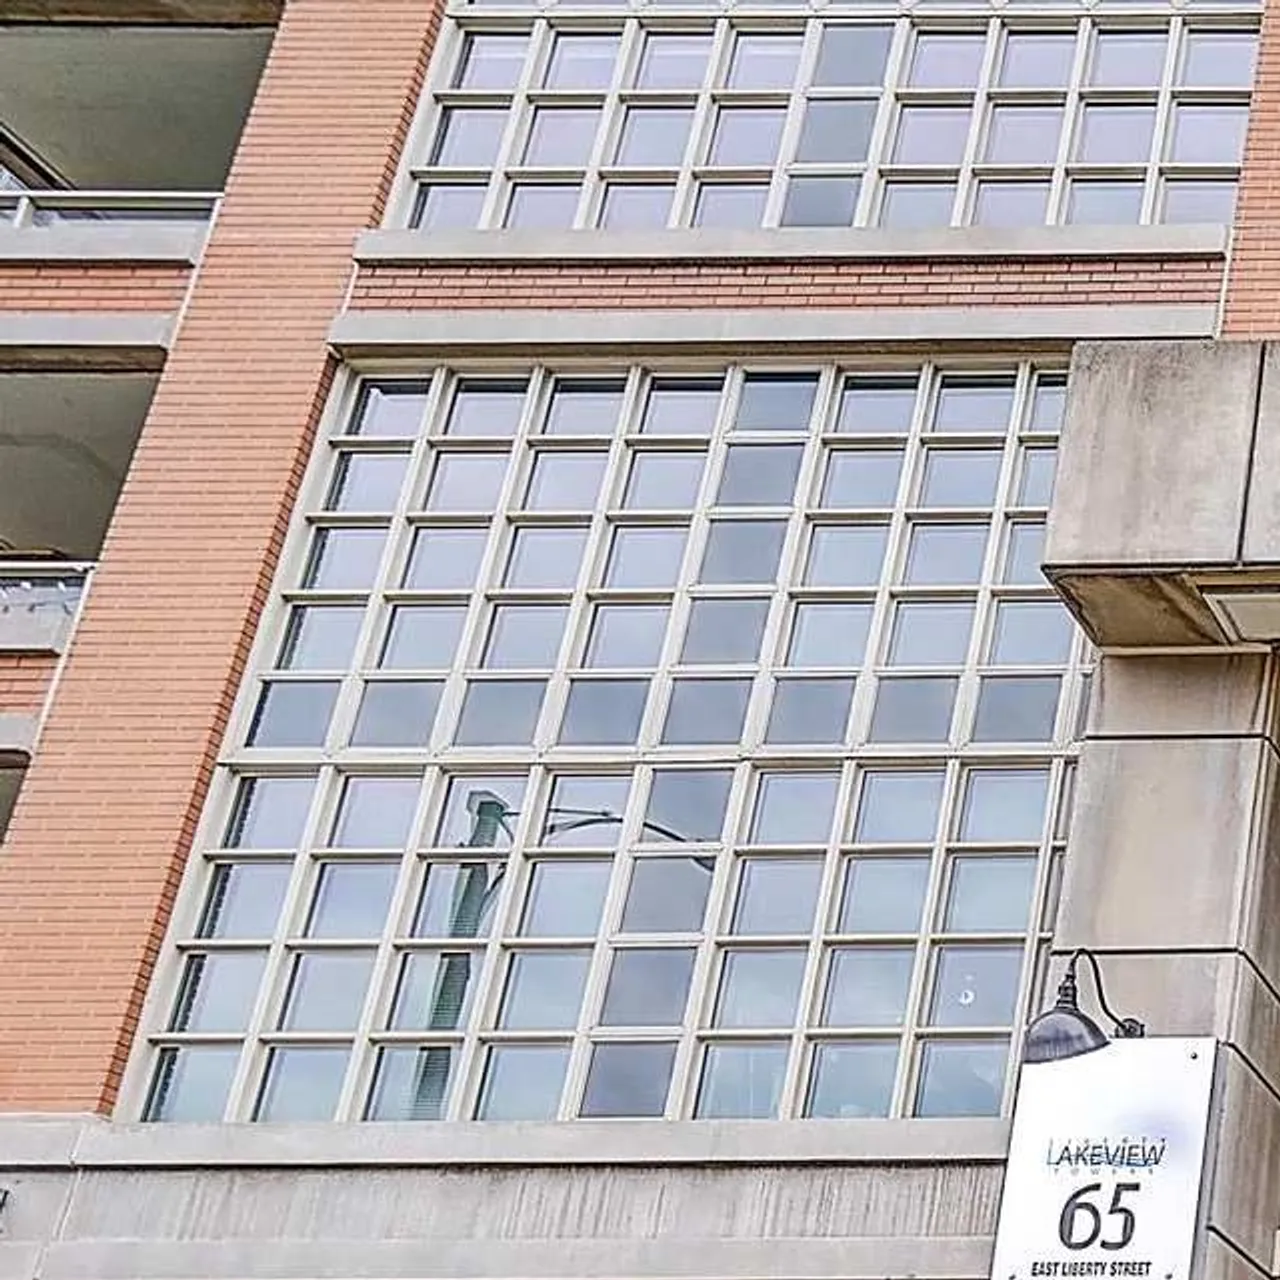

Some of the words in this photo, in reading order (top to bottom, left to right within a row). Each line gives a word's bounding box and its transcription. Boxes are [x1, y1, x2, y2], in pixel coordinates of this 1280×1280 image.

[1046, 1143, 1166, 1166] LAKEVIEW
[1058, 1181, 1141, 1251] 65
[1031, 1261, 1060, 1277] EAST
[1061, 1261, 1108, 1277] LIBERTY
[1110, 1261, 1153, 1277] STREET
